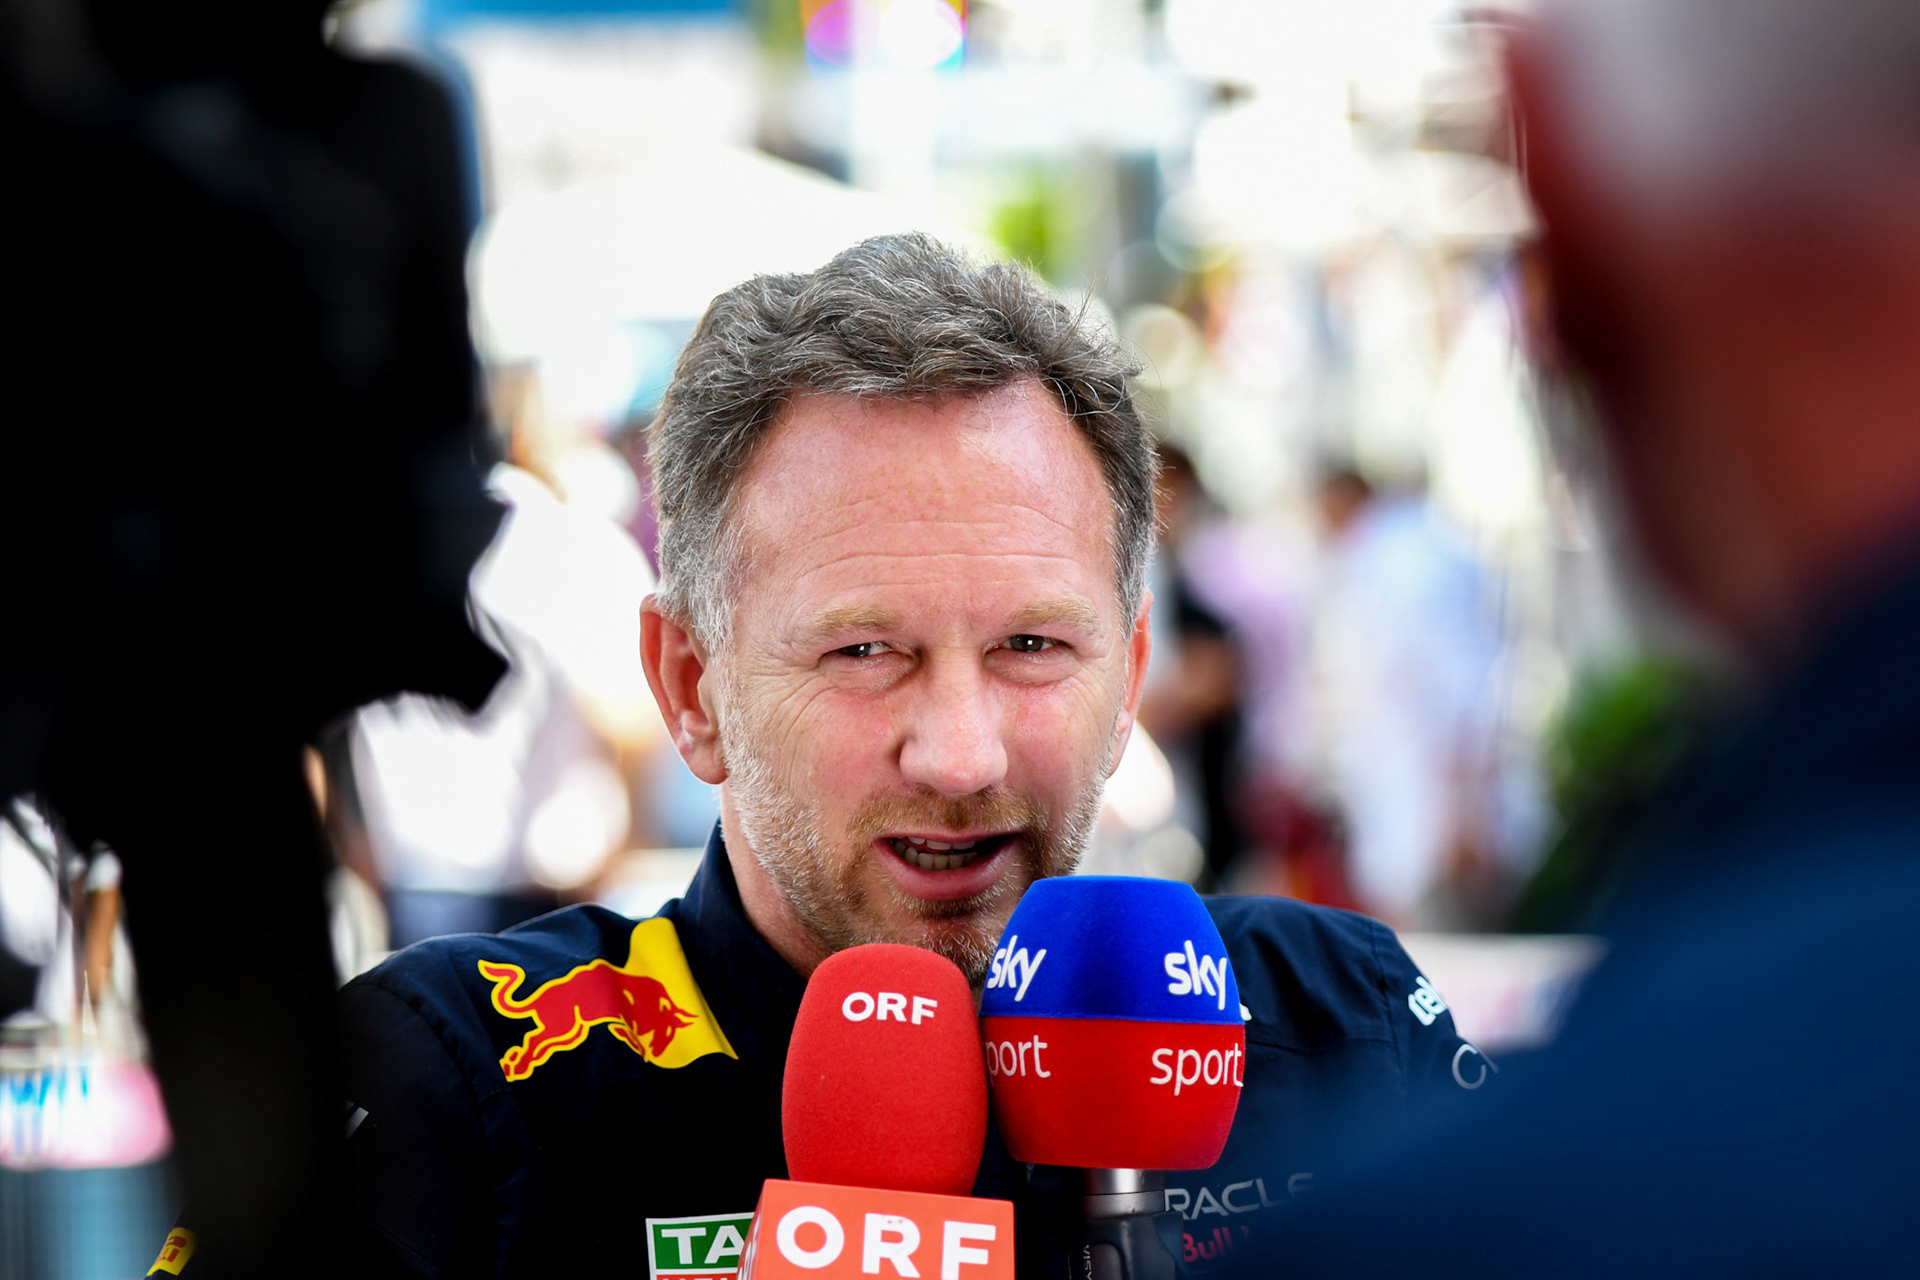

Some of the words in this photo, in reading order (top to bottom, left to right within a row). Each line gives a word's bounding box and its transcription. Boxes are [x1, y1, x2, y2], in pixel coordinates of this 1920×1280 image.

[987, 935, 1047, 1002] sky
[1164, 940, 1227, 1011] sky
[842, 992, 938, 1025] ORF
[985, 1035, 1051, 1086] port
[1149, 1043, 1244, 1096] sport
[1164, 1172, 1316, 1220] RACLE
[661, 1225, 746, 1265] TA
[776, 1205, 997, 1280] ORF
